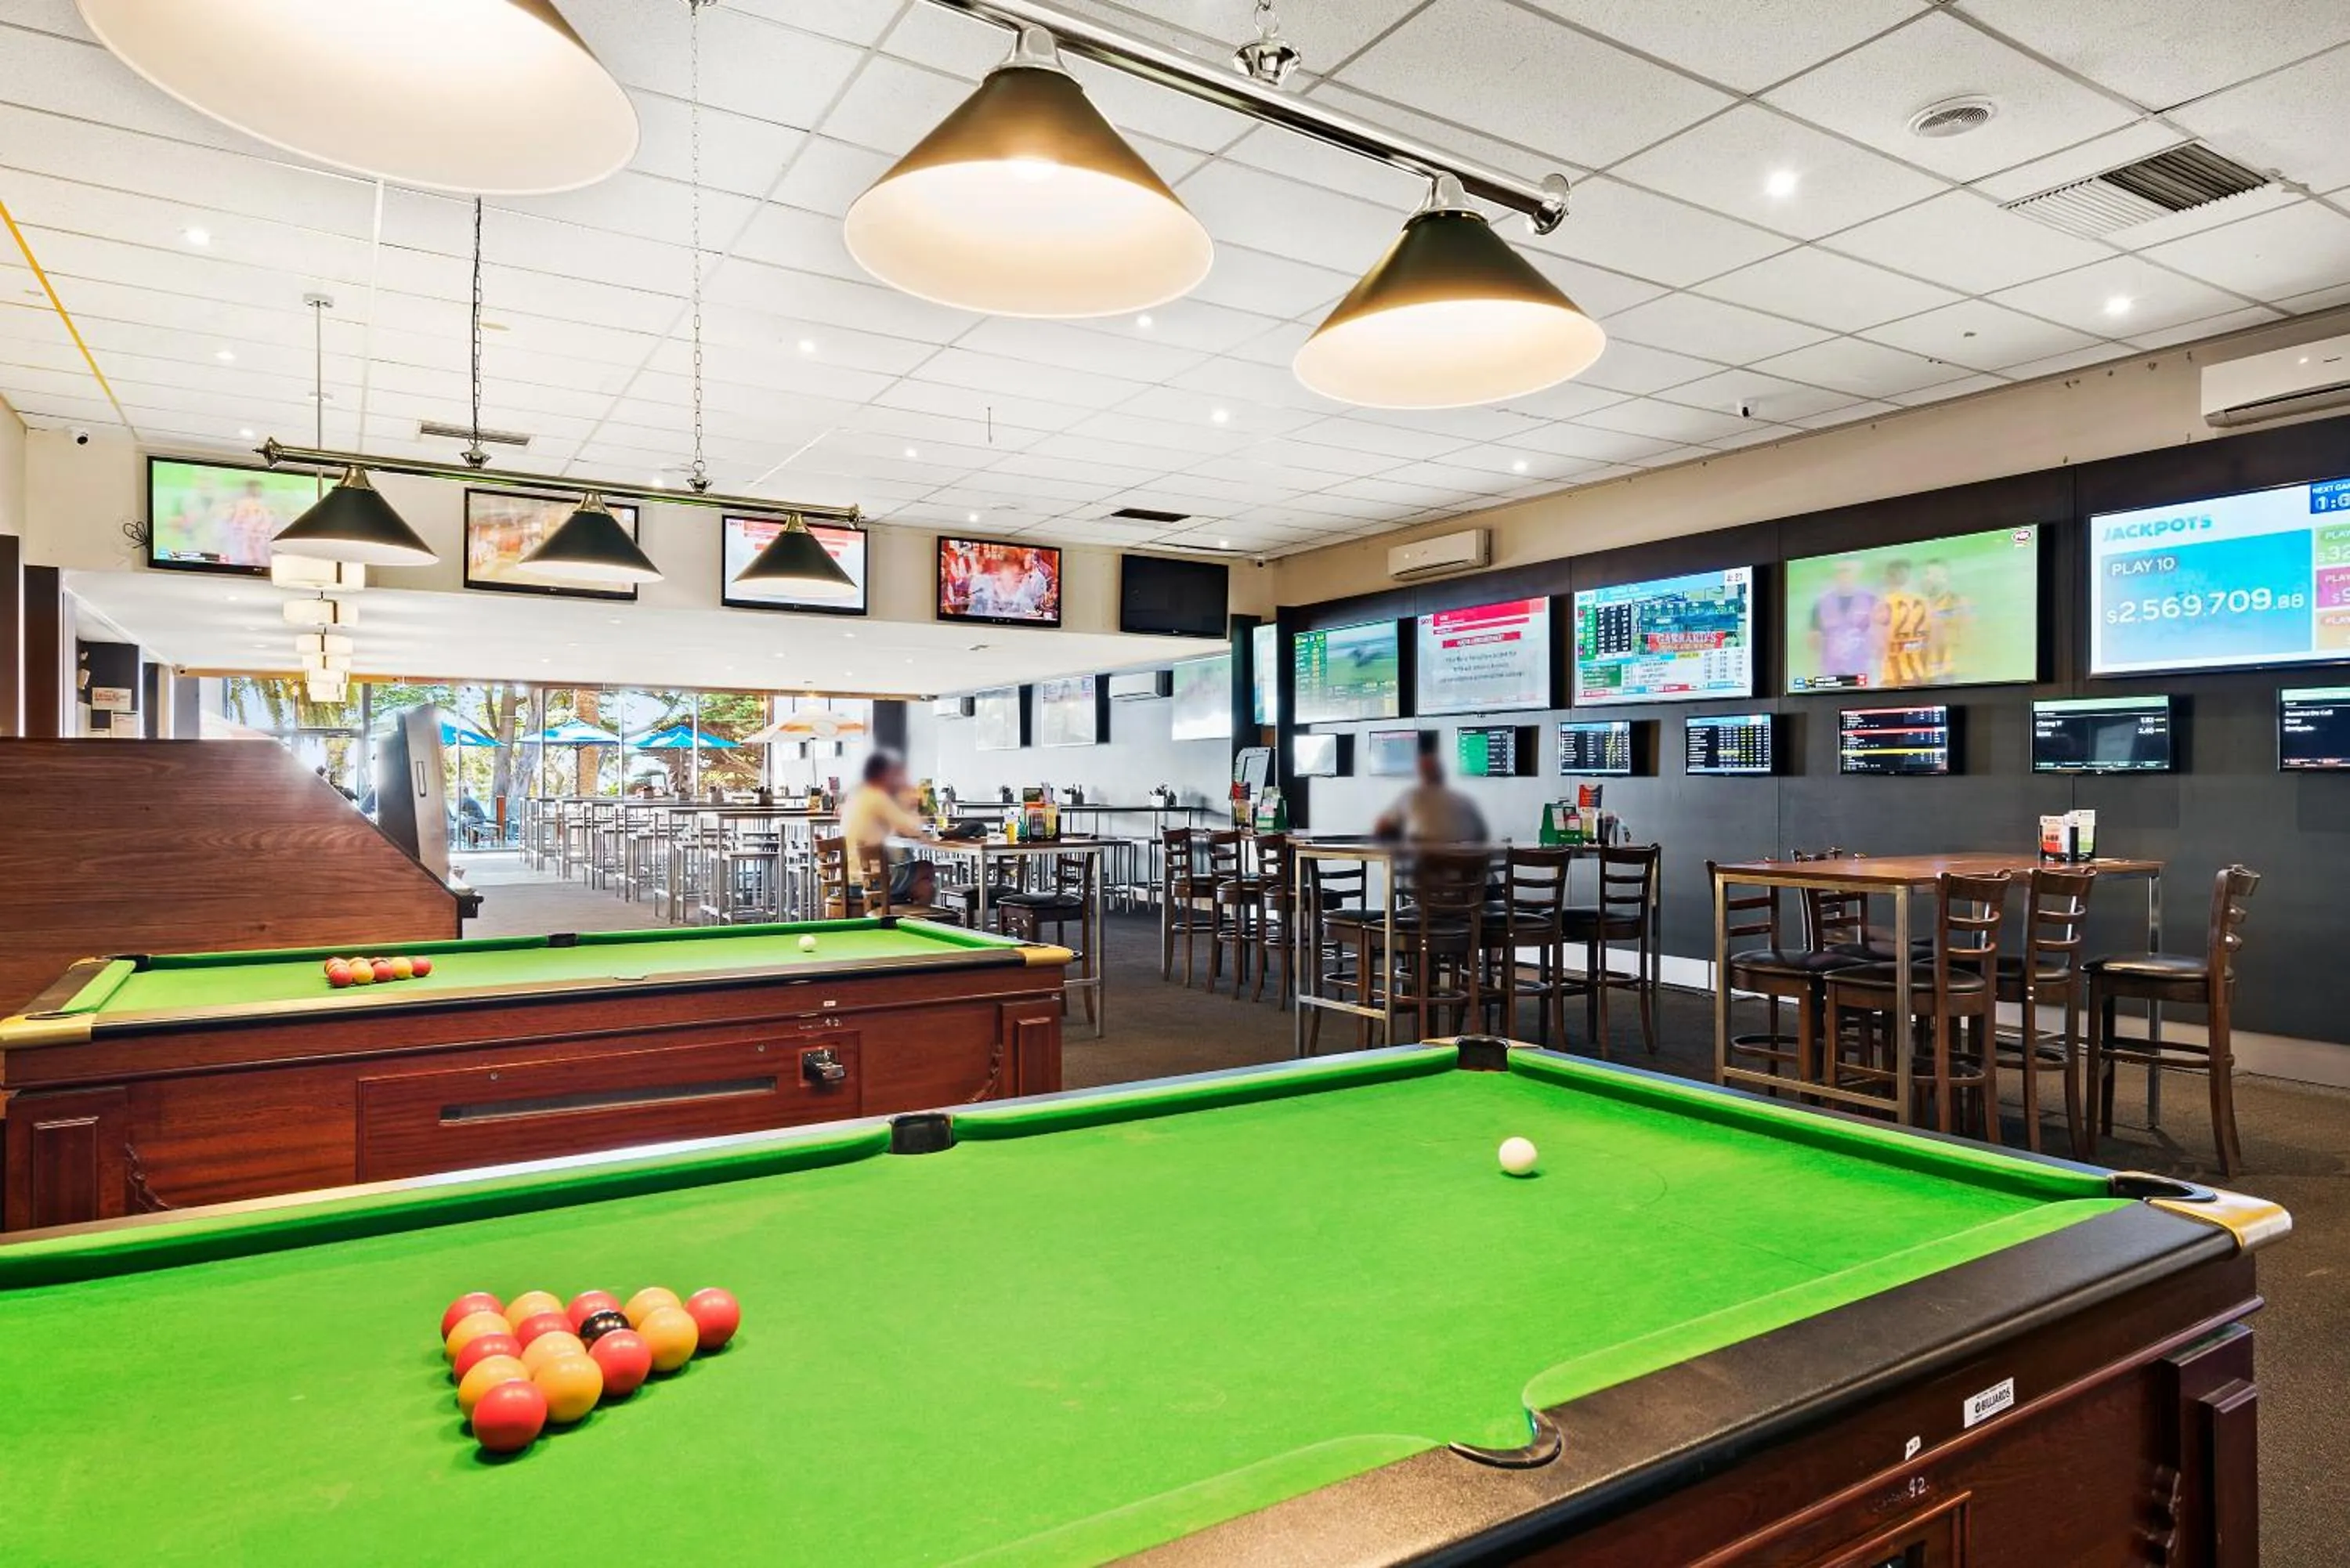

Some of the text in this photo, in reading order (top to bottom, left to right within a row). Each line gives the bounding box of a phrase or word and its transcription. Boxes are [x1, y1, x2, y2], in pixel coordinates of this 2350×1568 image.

[2103, 515, 2213, 541] JACKPOTS
[2111, 557, 2175, 576] PLAY 10
[1895, 600, 1930, 638] 22
[1981, 1386, 2011, 1411] BILLIARDS
